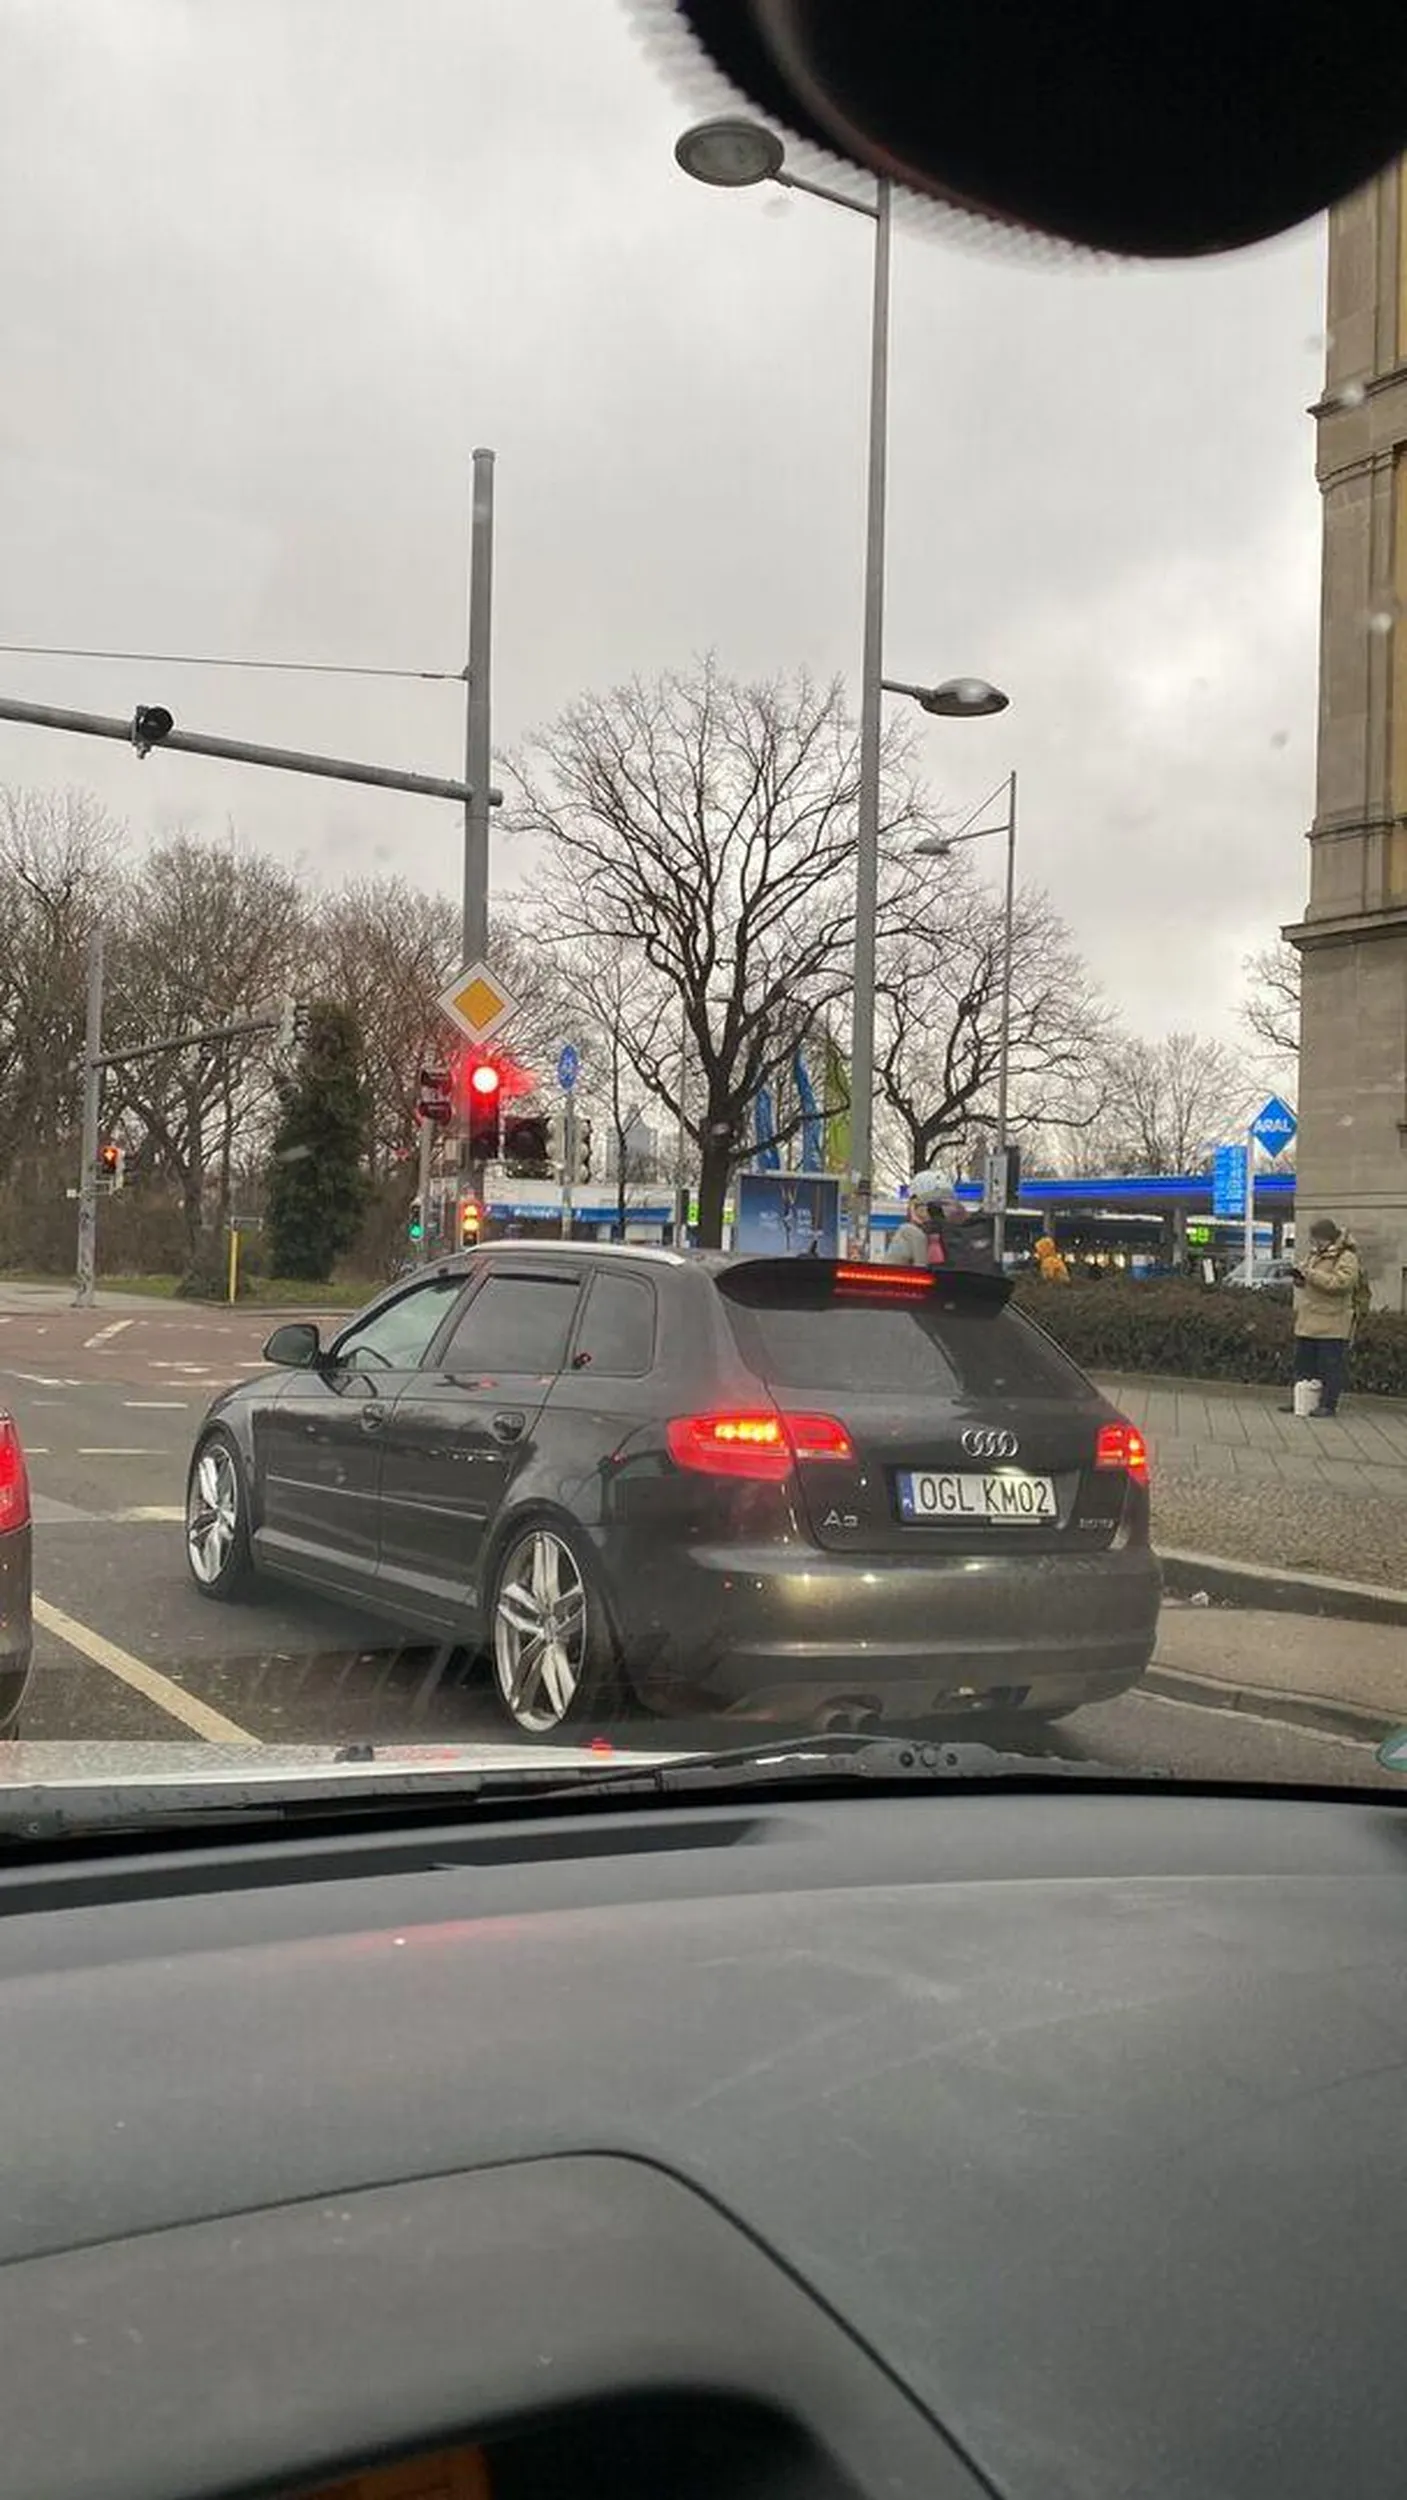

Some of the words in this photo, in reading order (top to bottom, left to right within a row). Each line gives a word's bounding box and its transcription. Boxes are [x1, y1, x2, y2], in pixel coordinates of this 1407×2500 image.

[1252, 1118, 1292, 1133] ARAL
[919, 1476, 975, 1511] OGL
[982, 1477, 1050, 1514] KM02
